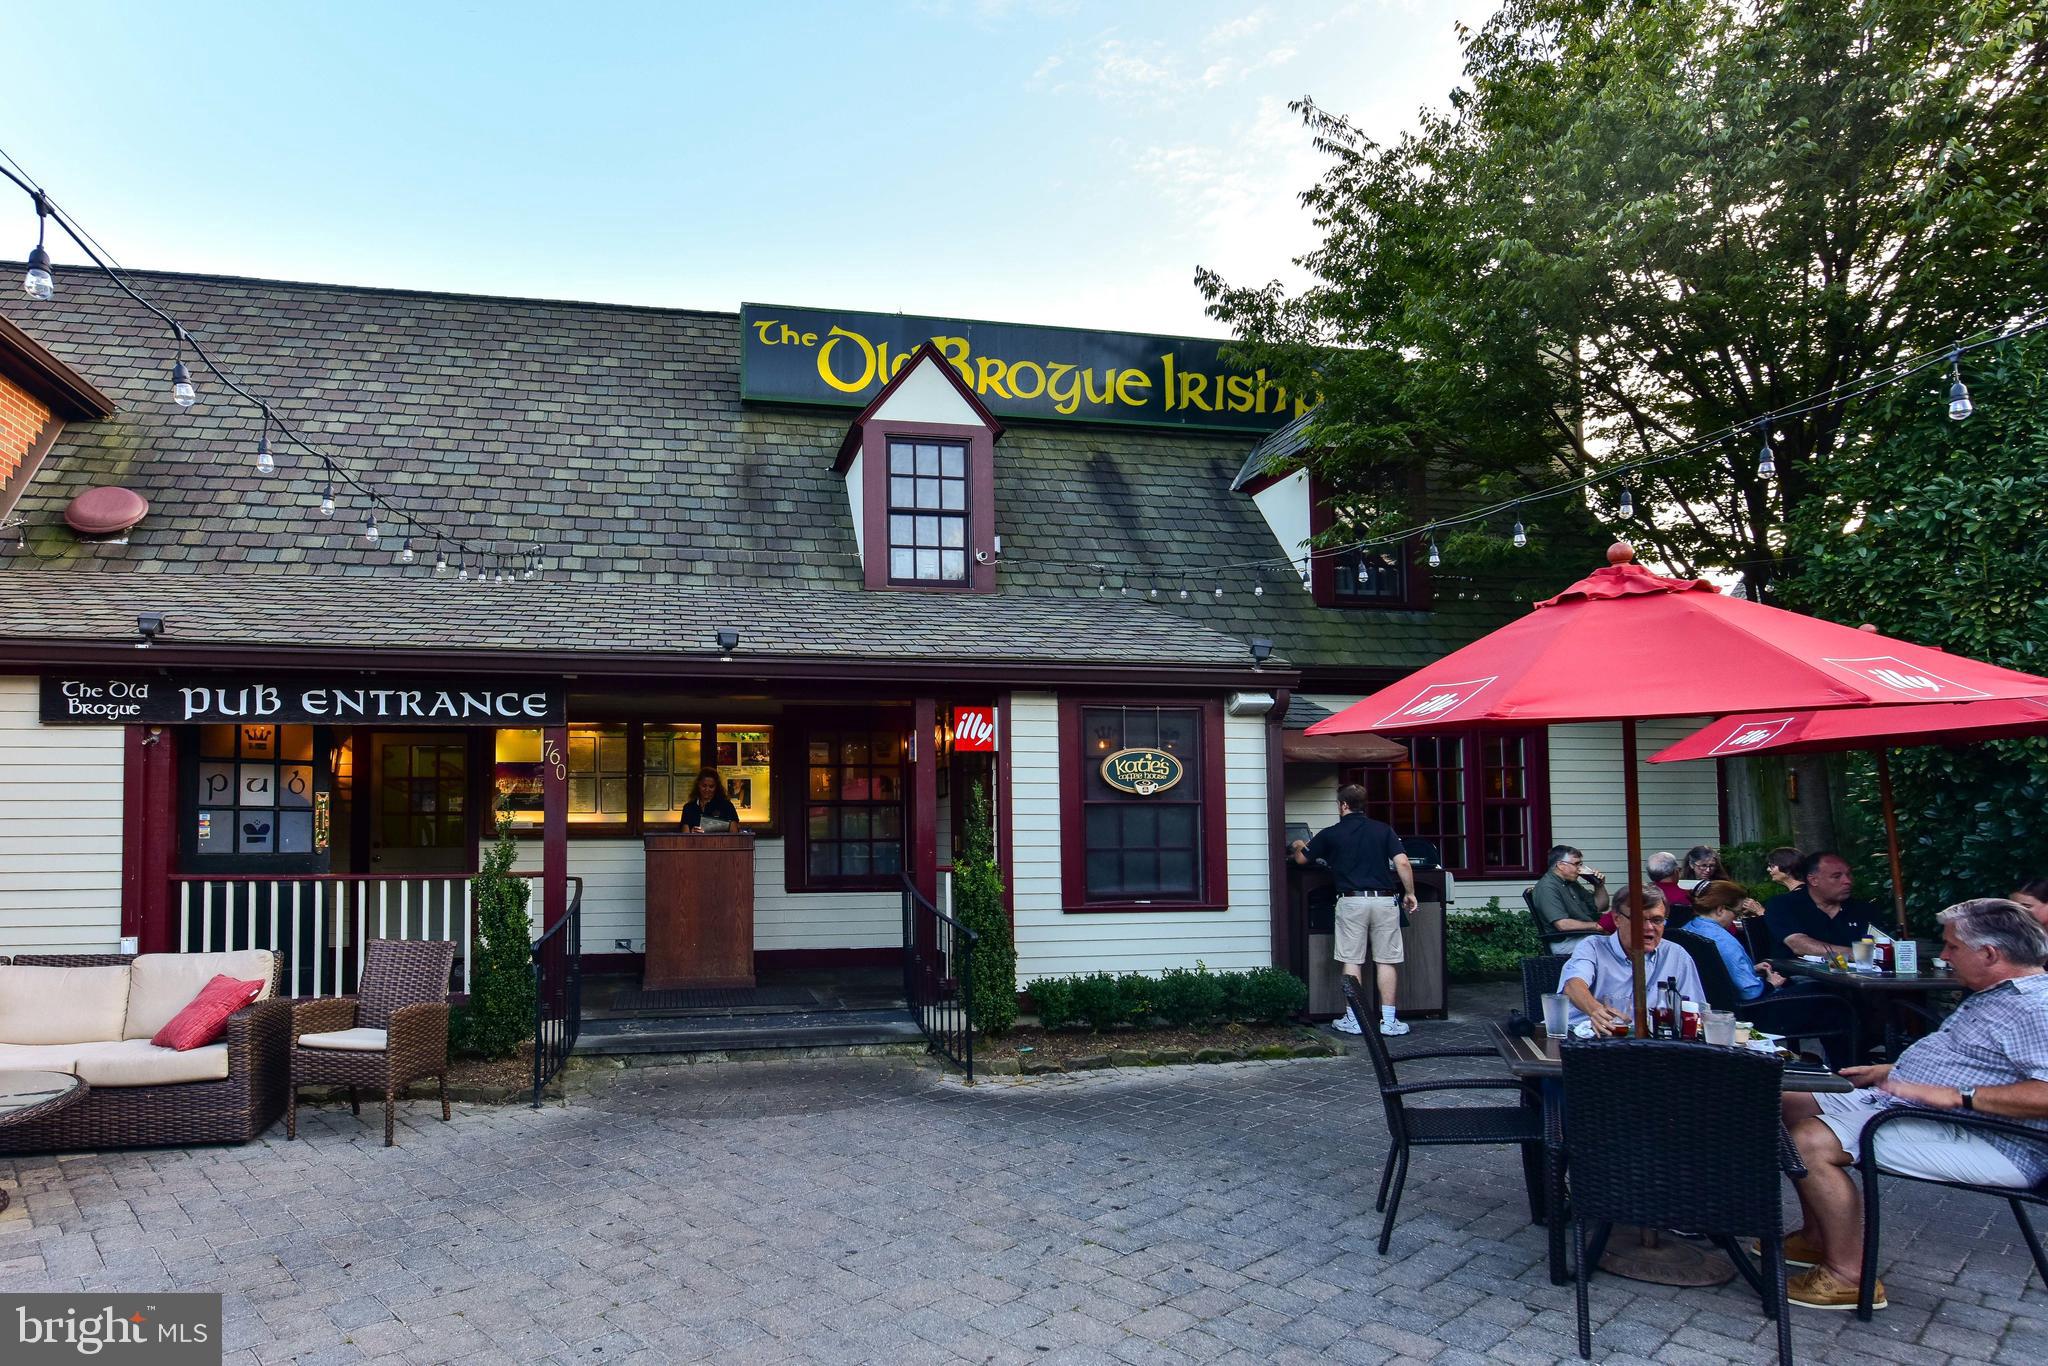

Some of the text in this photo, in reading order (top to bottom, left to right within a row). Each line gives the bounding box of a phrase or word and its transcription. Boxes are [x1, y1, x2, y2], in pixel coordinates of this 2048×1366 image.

[753, 320, 818, 347] The
[61, 680, 148, 698] The Old
[1866, 668, 1940, 692] illy
[301, 688, 549, 718] ENTRANCE
[955, 711, 993, 746] illy
